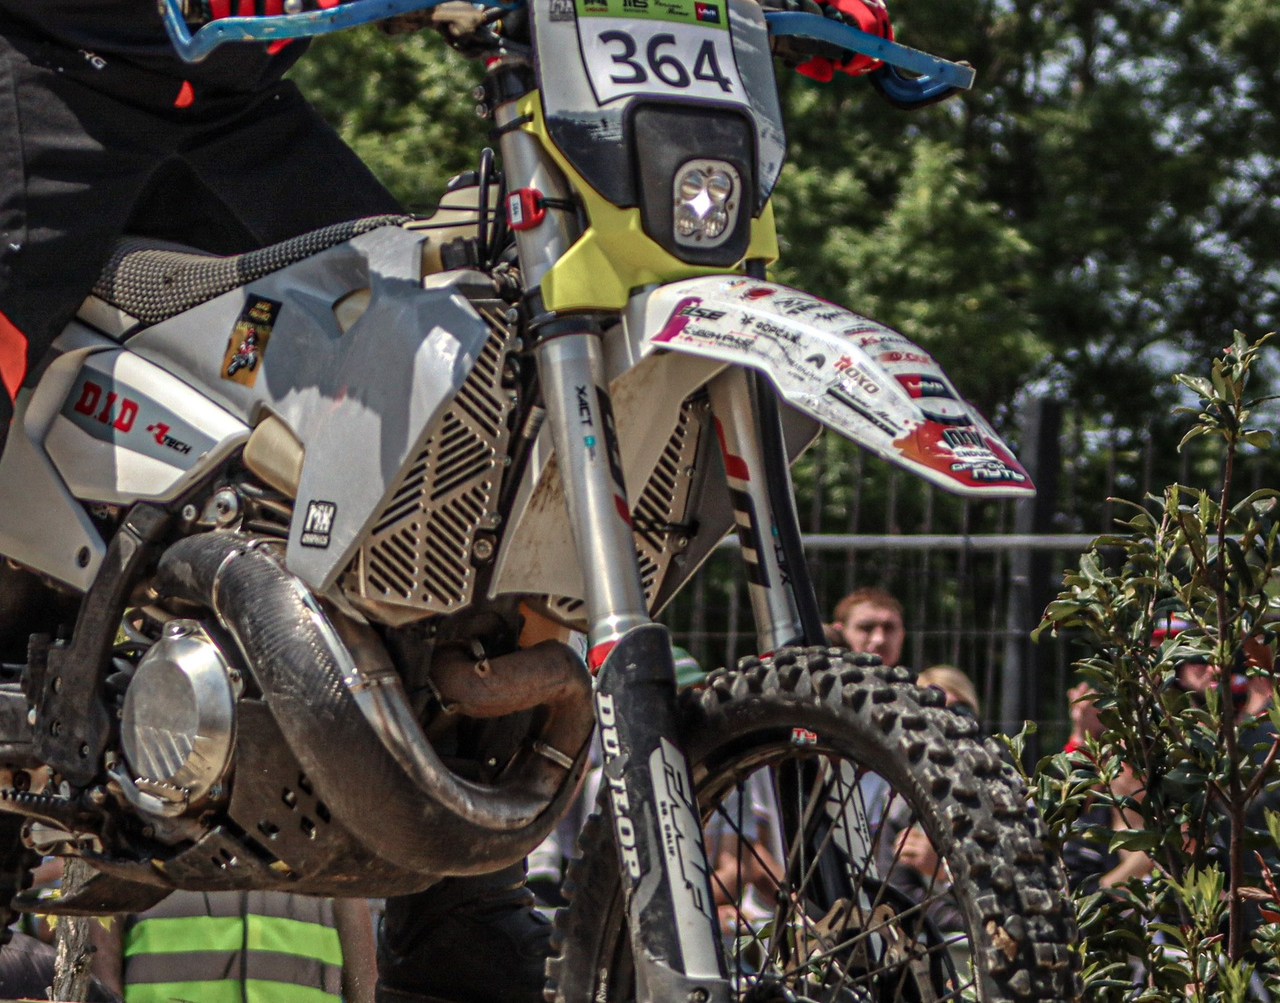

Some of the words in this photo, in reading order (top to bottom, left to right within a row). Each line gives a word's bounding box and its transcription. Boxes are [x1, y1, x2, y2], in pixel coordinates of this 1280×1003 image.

[598, 29, 734, 94] 364
[575, 384, 593, 427] XACT
[597, 692, 641, 879] DULOP
